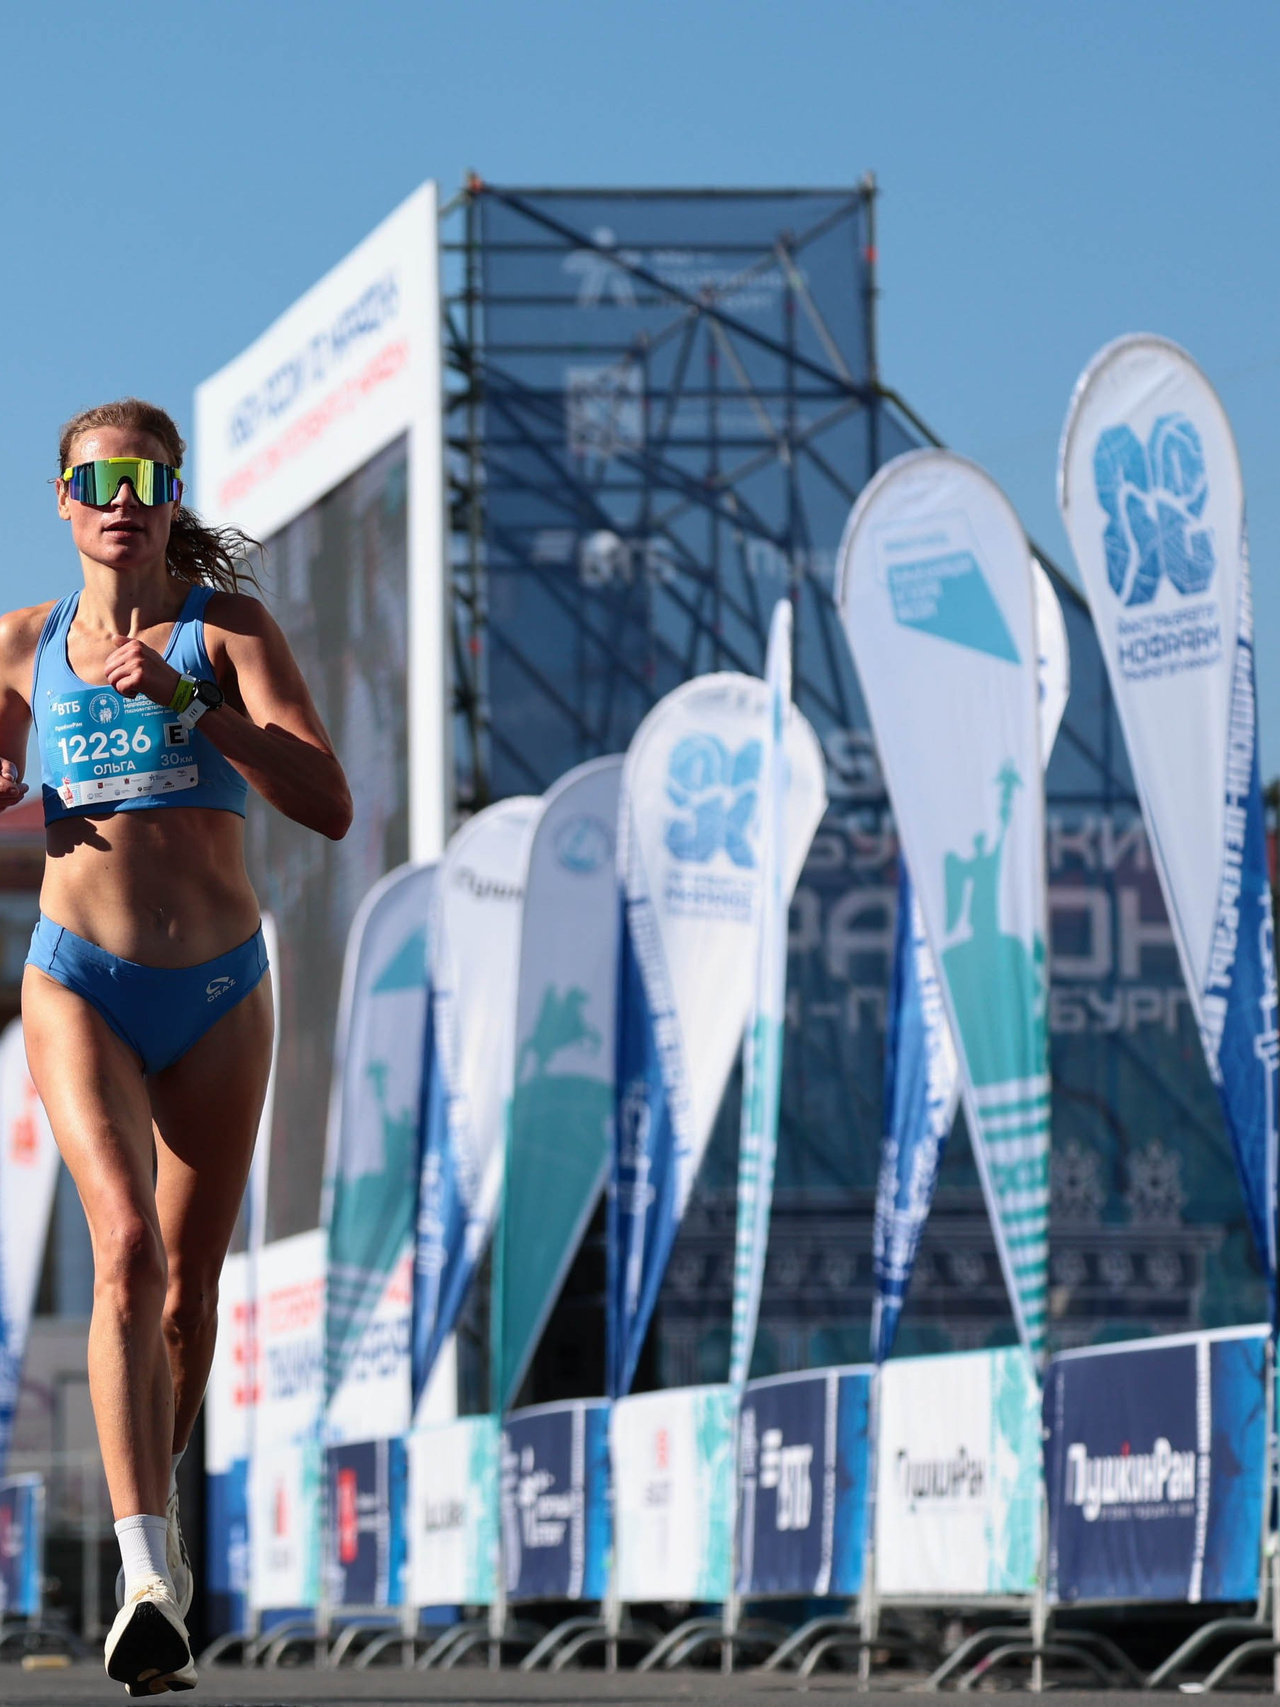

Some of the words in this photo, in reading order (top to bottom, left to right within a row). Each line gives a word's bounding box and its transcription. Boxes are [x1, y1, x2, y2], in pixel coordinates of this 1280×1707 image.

[58, 700, 81, 716] ВТБ
[169, 725, 184, 744] E
[58, 725, 151, 765] 12236
[93, 760, 136, 776] ОЛЬГА
[1065, 1436, 1195, 1522] ПушкинРан
